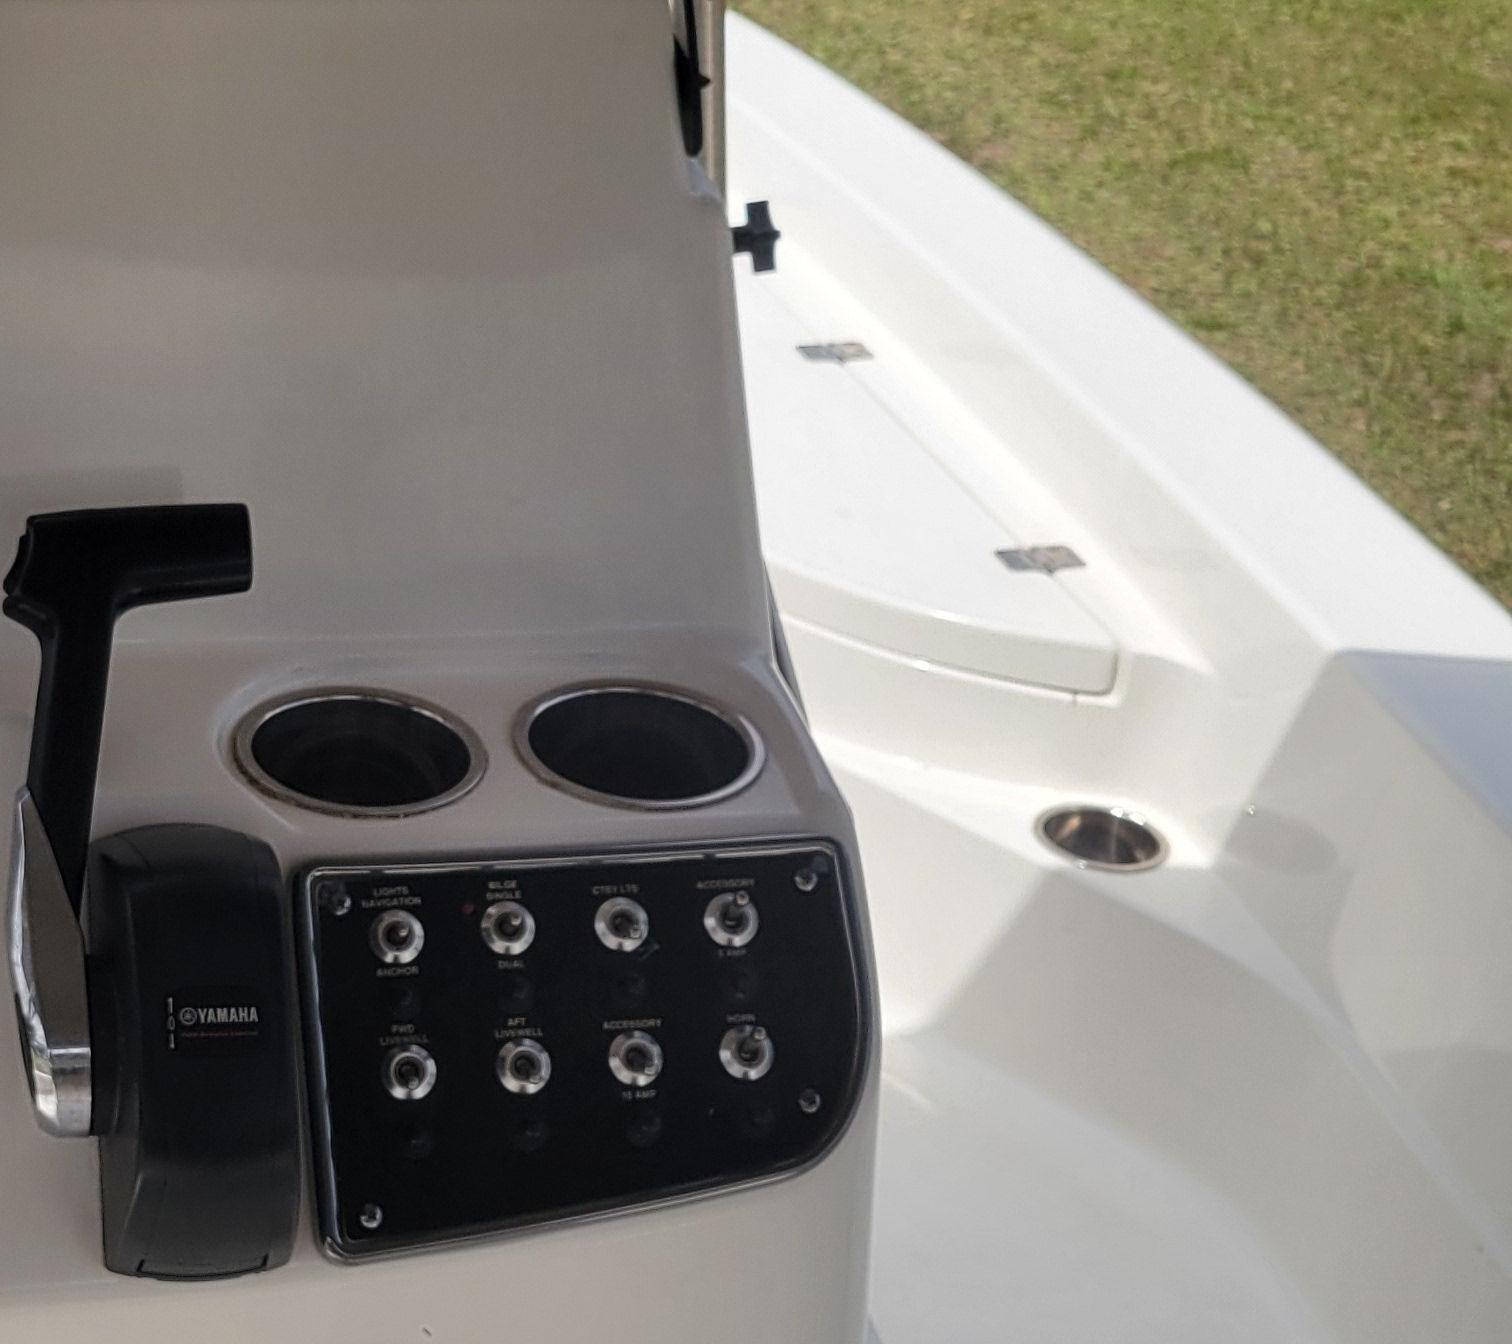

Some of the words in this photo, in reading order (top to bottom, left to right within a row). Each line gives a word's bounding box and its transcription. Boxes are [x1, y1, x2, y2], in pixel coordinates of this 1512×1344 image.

[487, 879, 518, 889] BILGE
[696, 878, 755, 890] ACCESSORY
[373, 885, 409, 897] LIGHTS
[485, 890, 522, 901] SINGLE
[360, 896, 422, 909] NAVIGATION
[497, 959, 524, 970] DUAL
[375, 965, 420, 977] ANCHOR
[197, 1006, 259, 1024] YAMAHA
[726, 1013, 756, 1024] HORN
[507, 1017, 527, 1027] AFT
[602, 1018, 663, 1030] ACCESSORY
[390, 1023, 416, 1034] FWD
[495, 1027, 544, 1039] LIVEWELL
[379, 1034, 430, 1046] LIVEWELL
[634, 1089, 657, 1099] AMP
